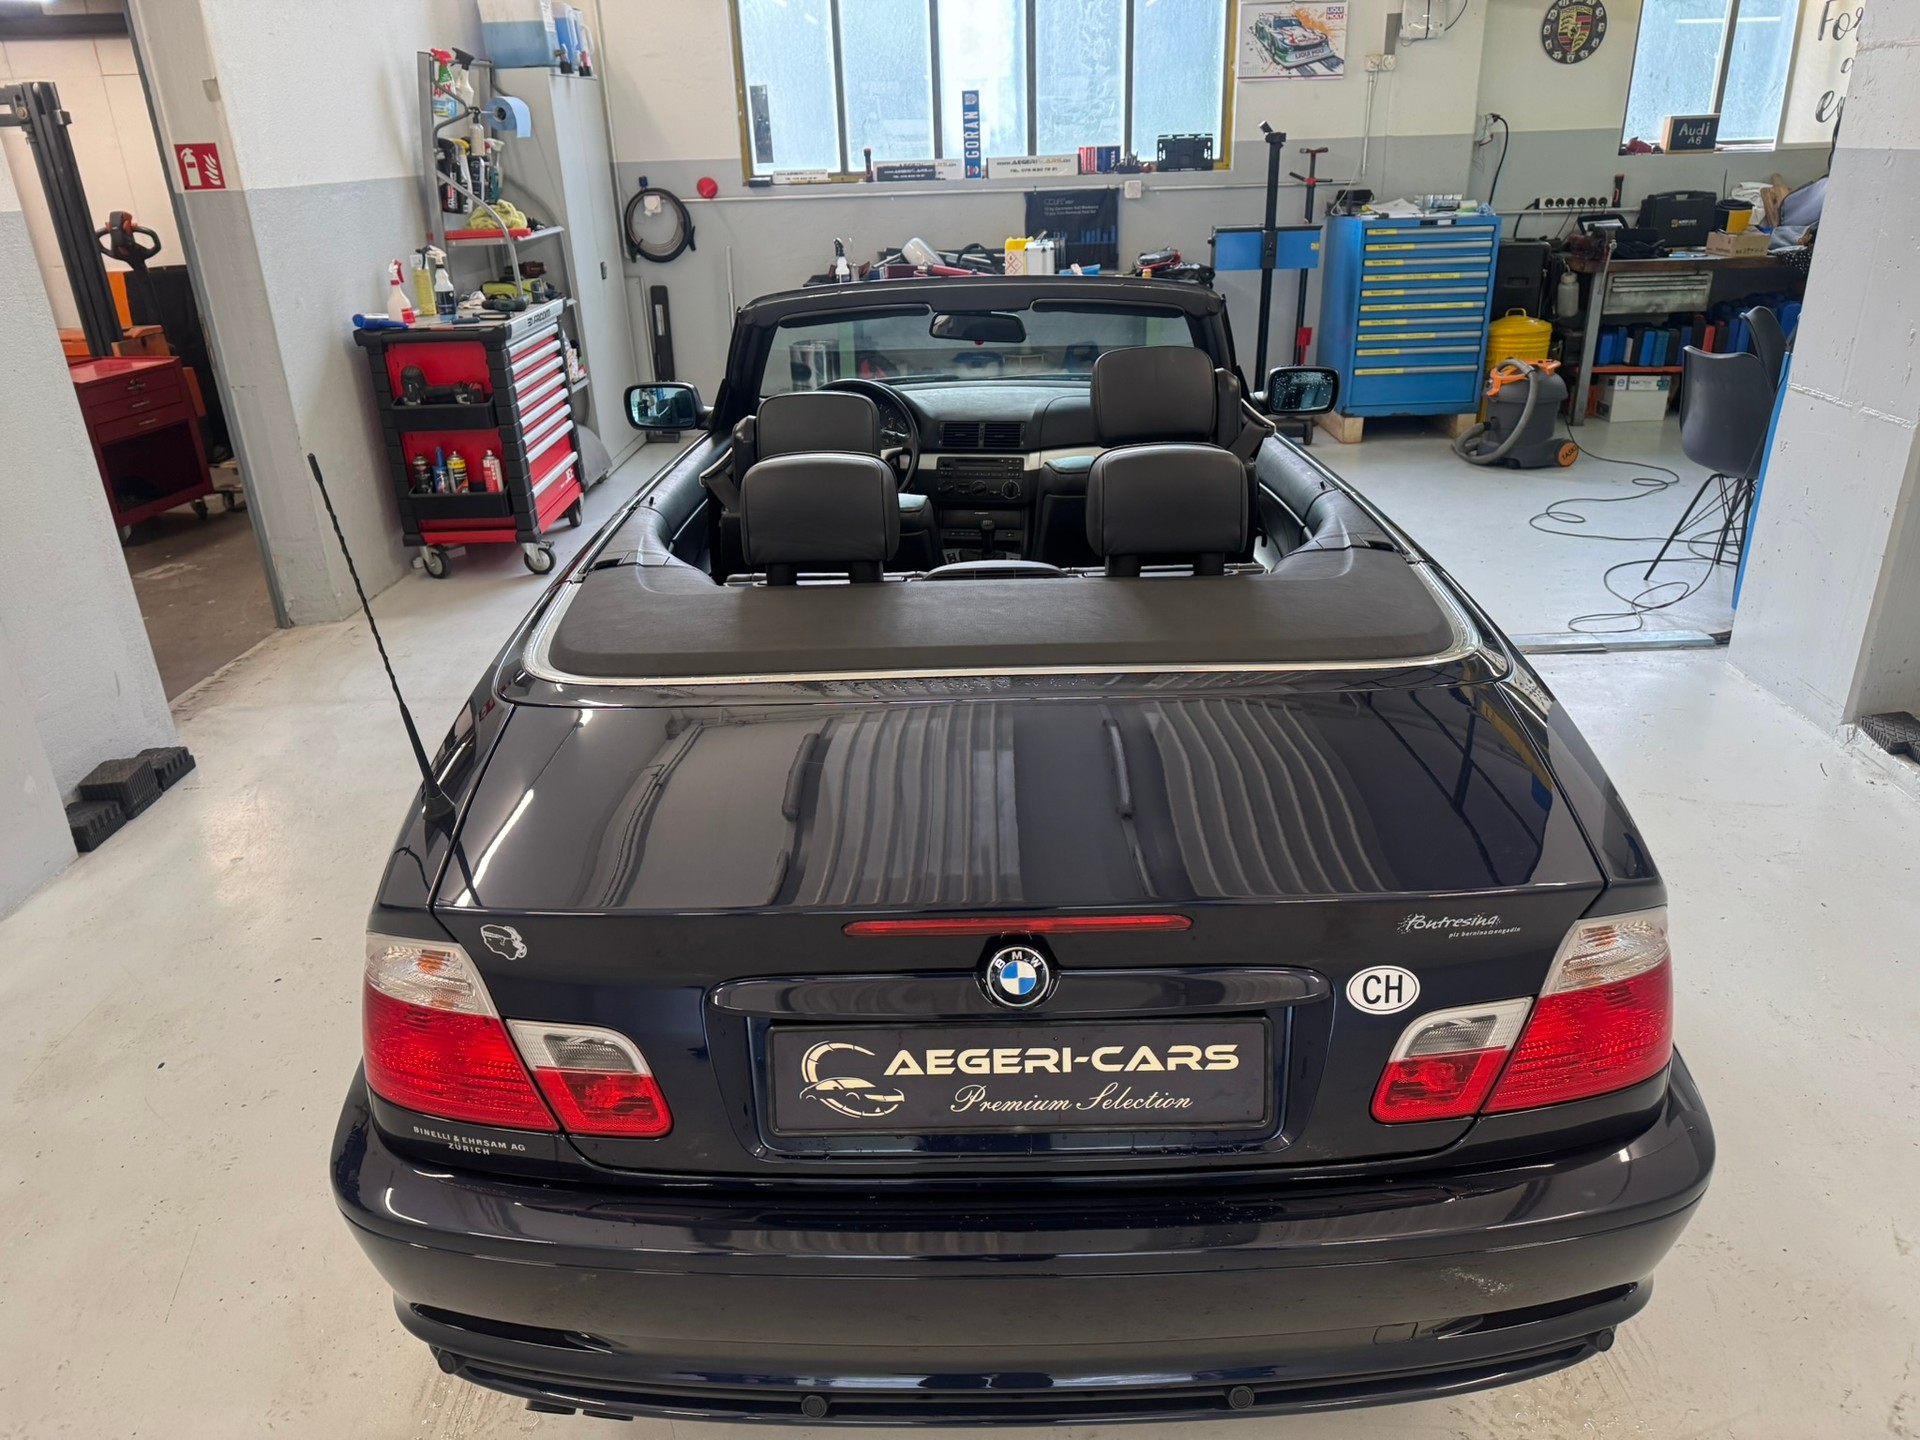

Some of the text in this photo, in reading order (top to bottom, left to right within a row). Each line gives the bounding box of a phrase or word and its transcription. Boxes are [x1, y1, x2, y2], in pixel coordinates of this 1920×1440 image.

[964, 110, 981, 159] GORAN
[1678, 122, 1711, 137] Audi
[1405, 914, 1498, 931] Pontresina
[994, 951, 1042, 969] BMW
[1362, 974, 1403, 1005] CH
[883, 1044, 1240, 1076] AEGERI-CARS
[950, 1081, 1194, 1113] Premium Selection
[413, 1126, 451, 1140] BINELLI
[461, 1136, 507, 1149] EHRSAM
[510, 1143, 526, 1151] AG
[448, 1142, 490, 1156] ZÜRICH
